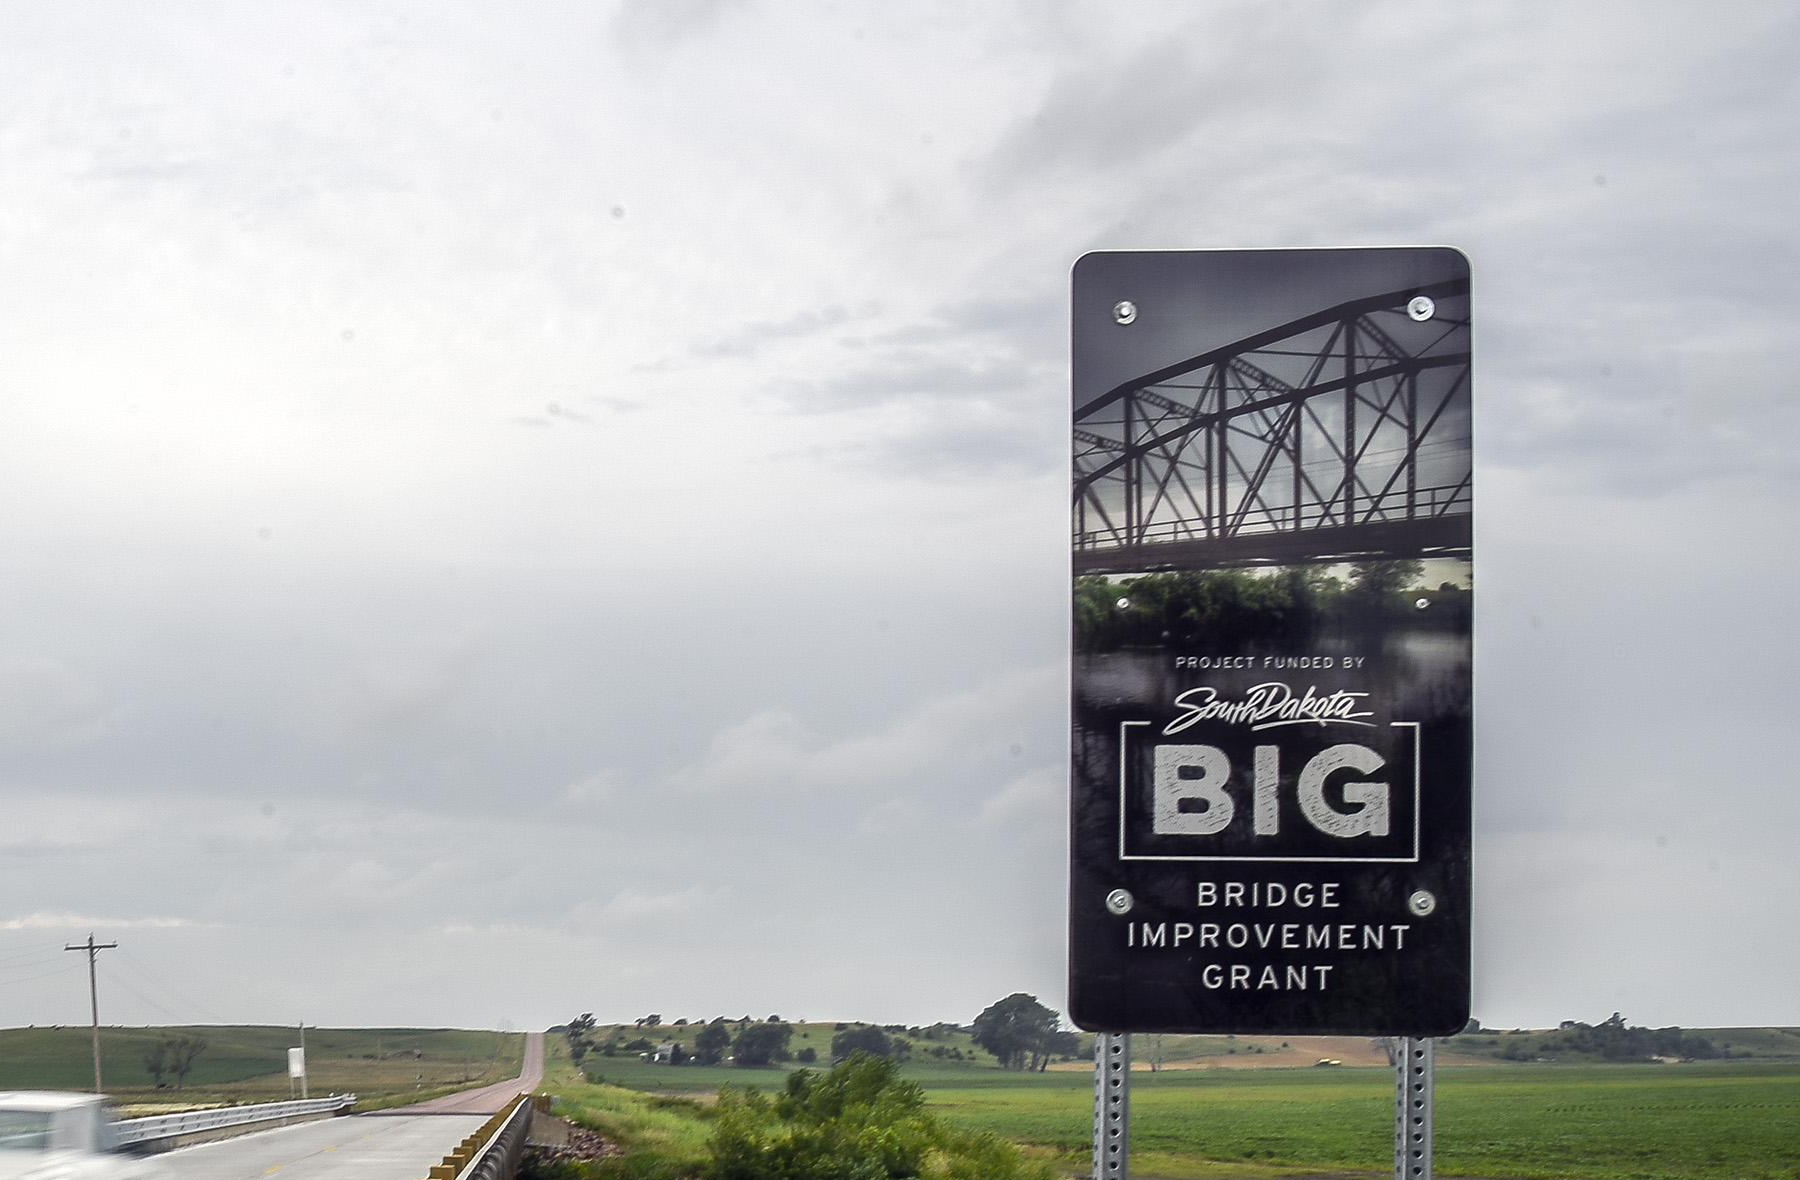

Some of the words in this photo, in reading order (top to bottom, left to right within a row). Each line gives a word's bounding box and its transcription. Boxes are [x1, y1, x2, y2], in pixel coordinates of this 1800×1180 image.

[1175, 656, 1255, 669] PROJECT
[1263, 656, 1334, 669] FUNDED
[1342, 656, 1365, 669] BY
[1153, 743, 1391, 838] BIG
[1198, 882, 1340, 908] BRIDGE
[1128, 922, 1410, 950] IMPROVEMENT
[1202, 965, 1333, 991] GRANT
